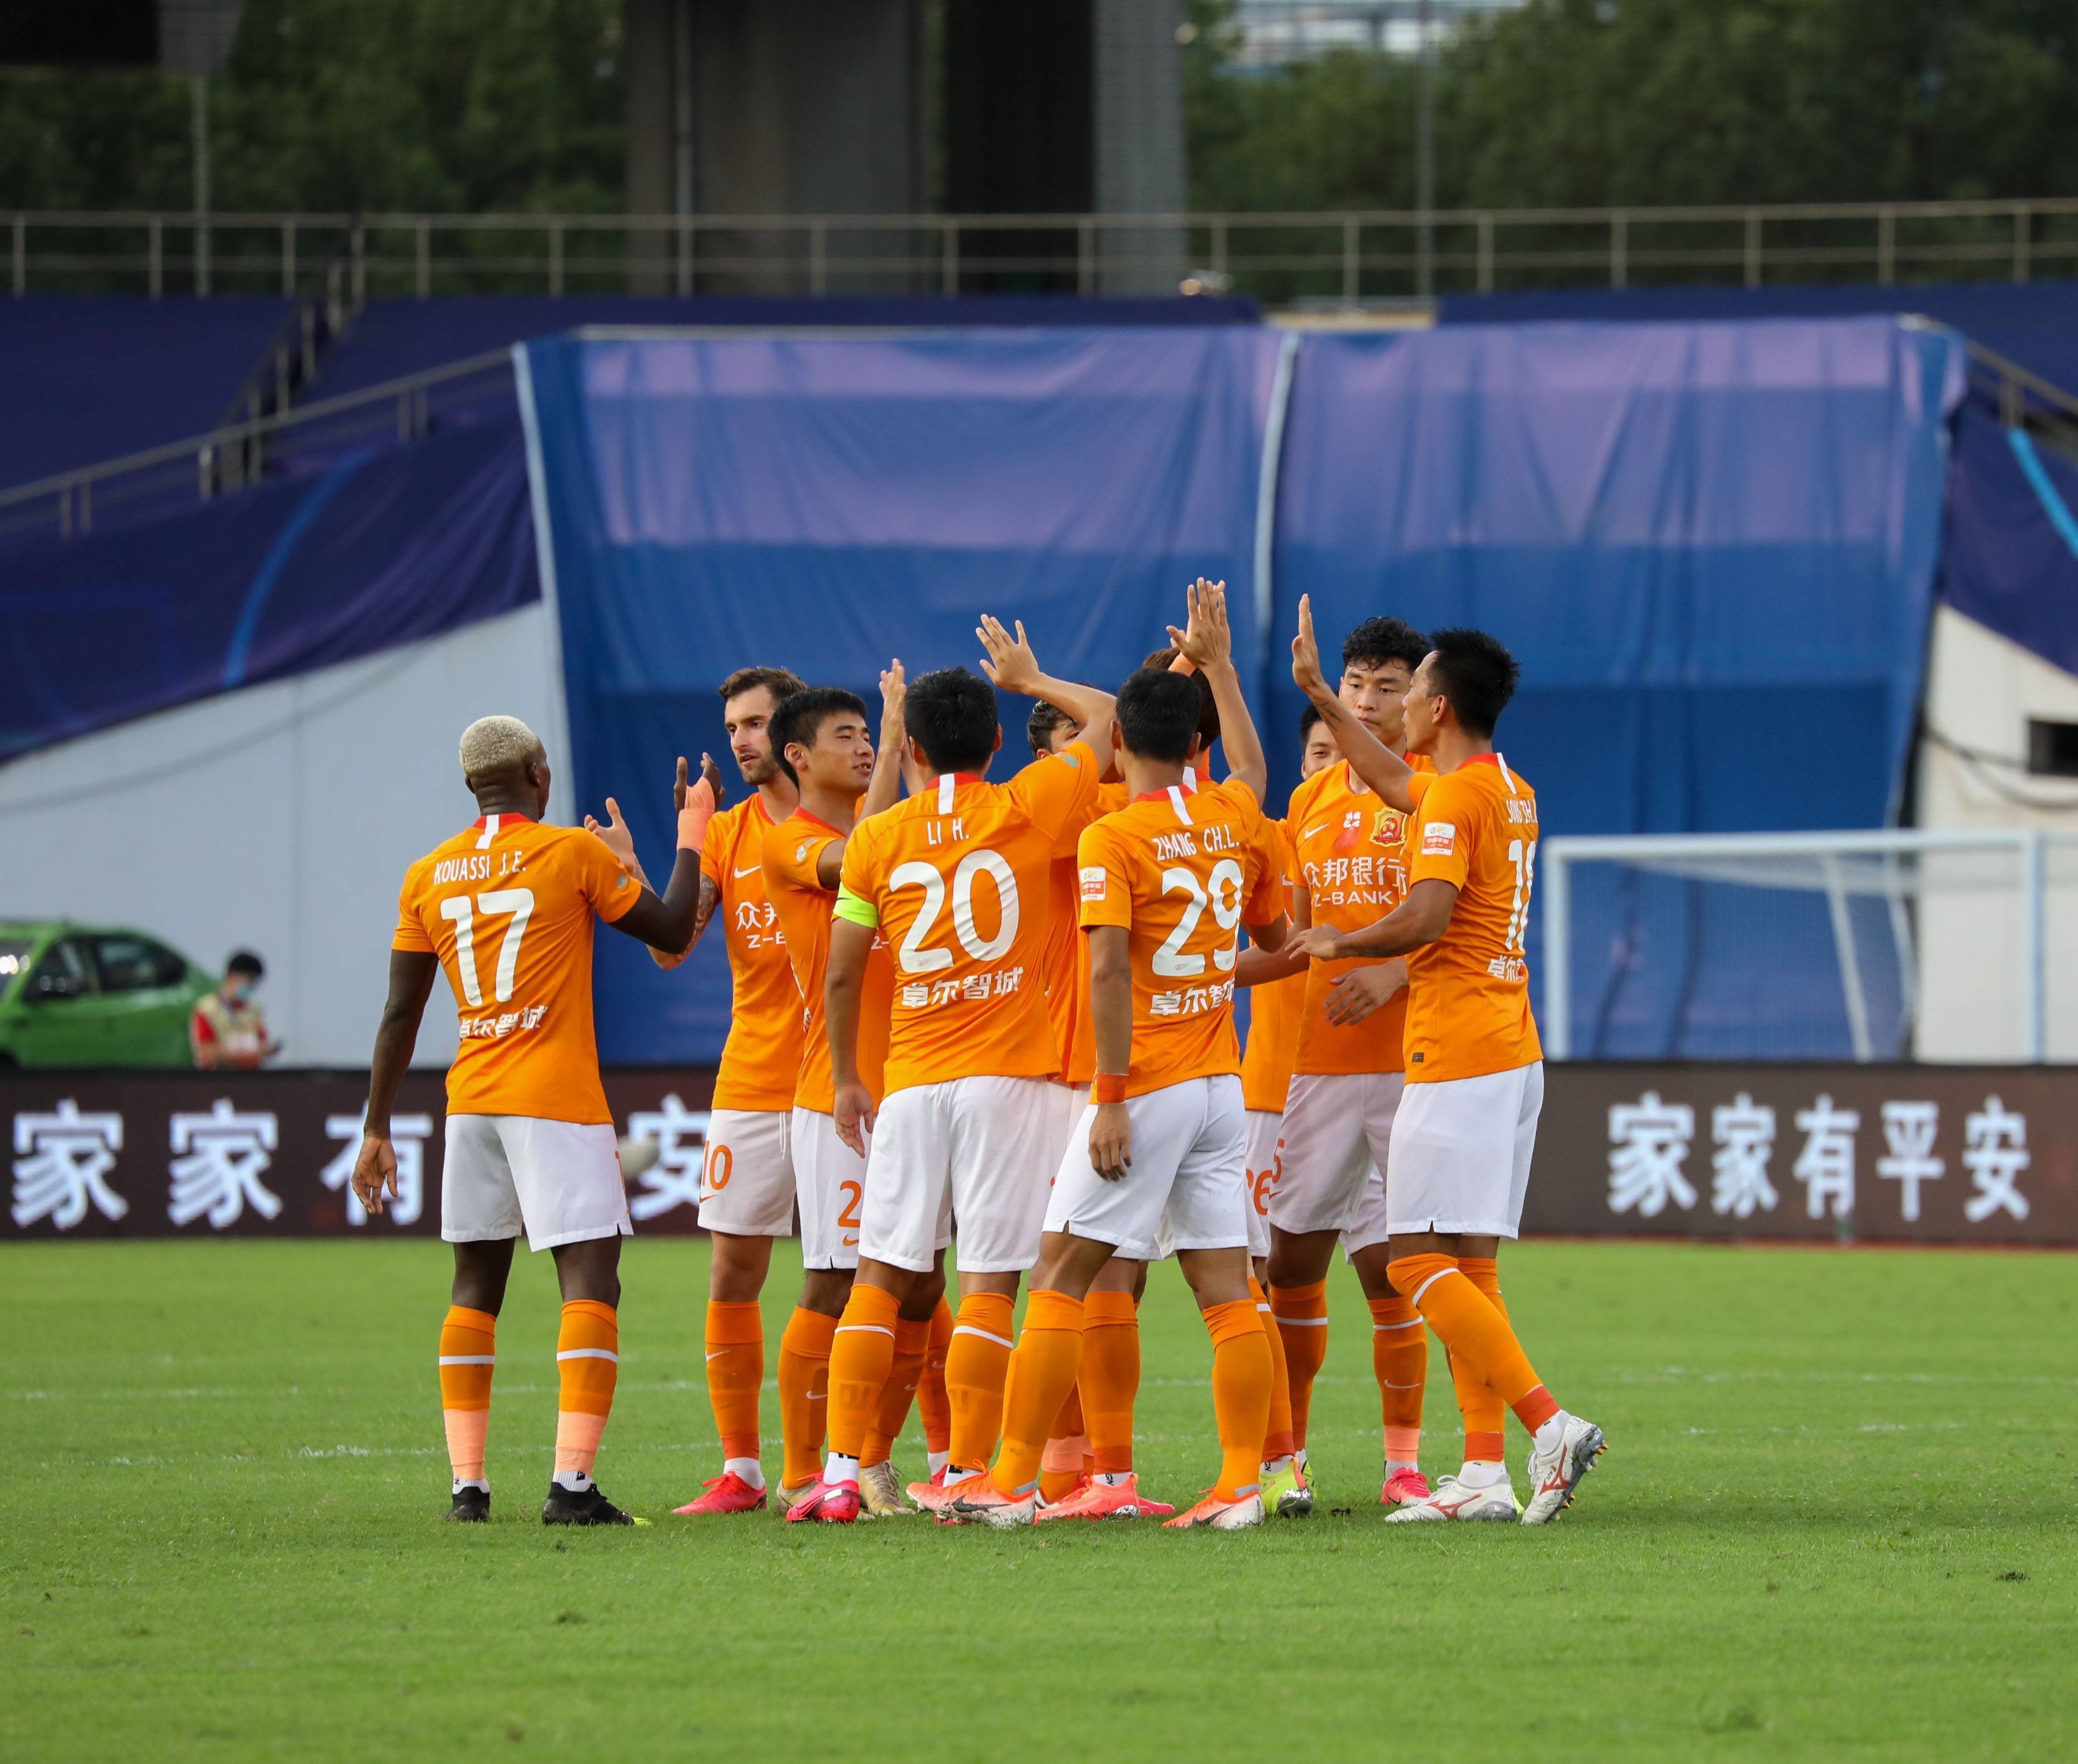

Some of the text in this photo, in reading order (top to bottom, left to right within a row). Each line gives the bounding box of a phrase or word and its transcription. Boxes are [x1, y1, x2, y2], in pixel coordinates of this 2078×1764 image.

[927, 817, 970, 845] LI H.
[1151, 823, 1239, 861] ZHANG CH.L.
[433, 850, 526, 886] KOUASSI J.E.
[1303, 856, 1400, 888] 众邦银行
[889, 849, 1020, 973] 20
[1152, 859, 1244, 977] 29
[1314, 890, 1393, 908] Z-BANK
[440, 888, 534, 1006] 17
[902, 966, 1023, 1007] 卓尔智城
[1607, 1090, 2031, 1222] 家家有平安
